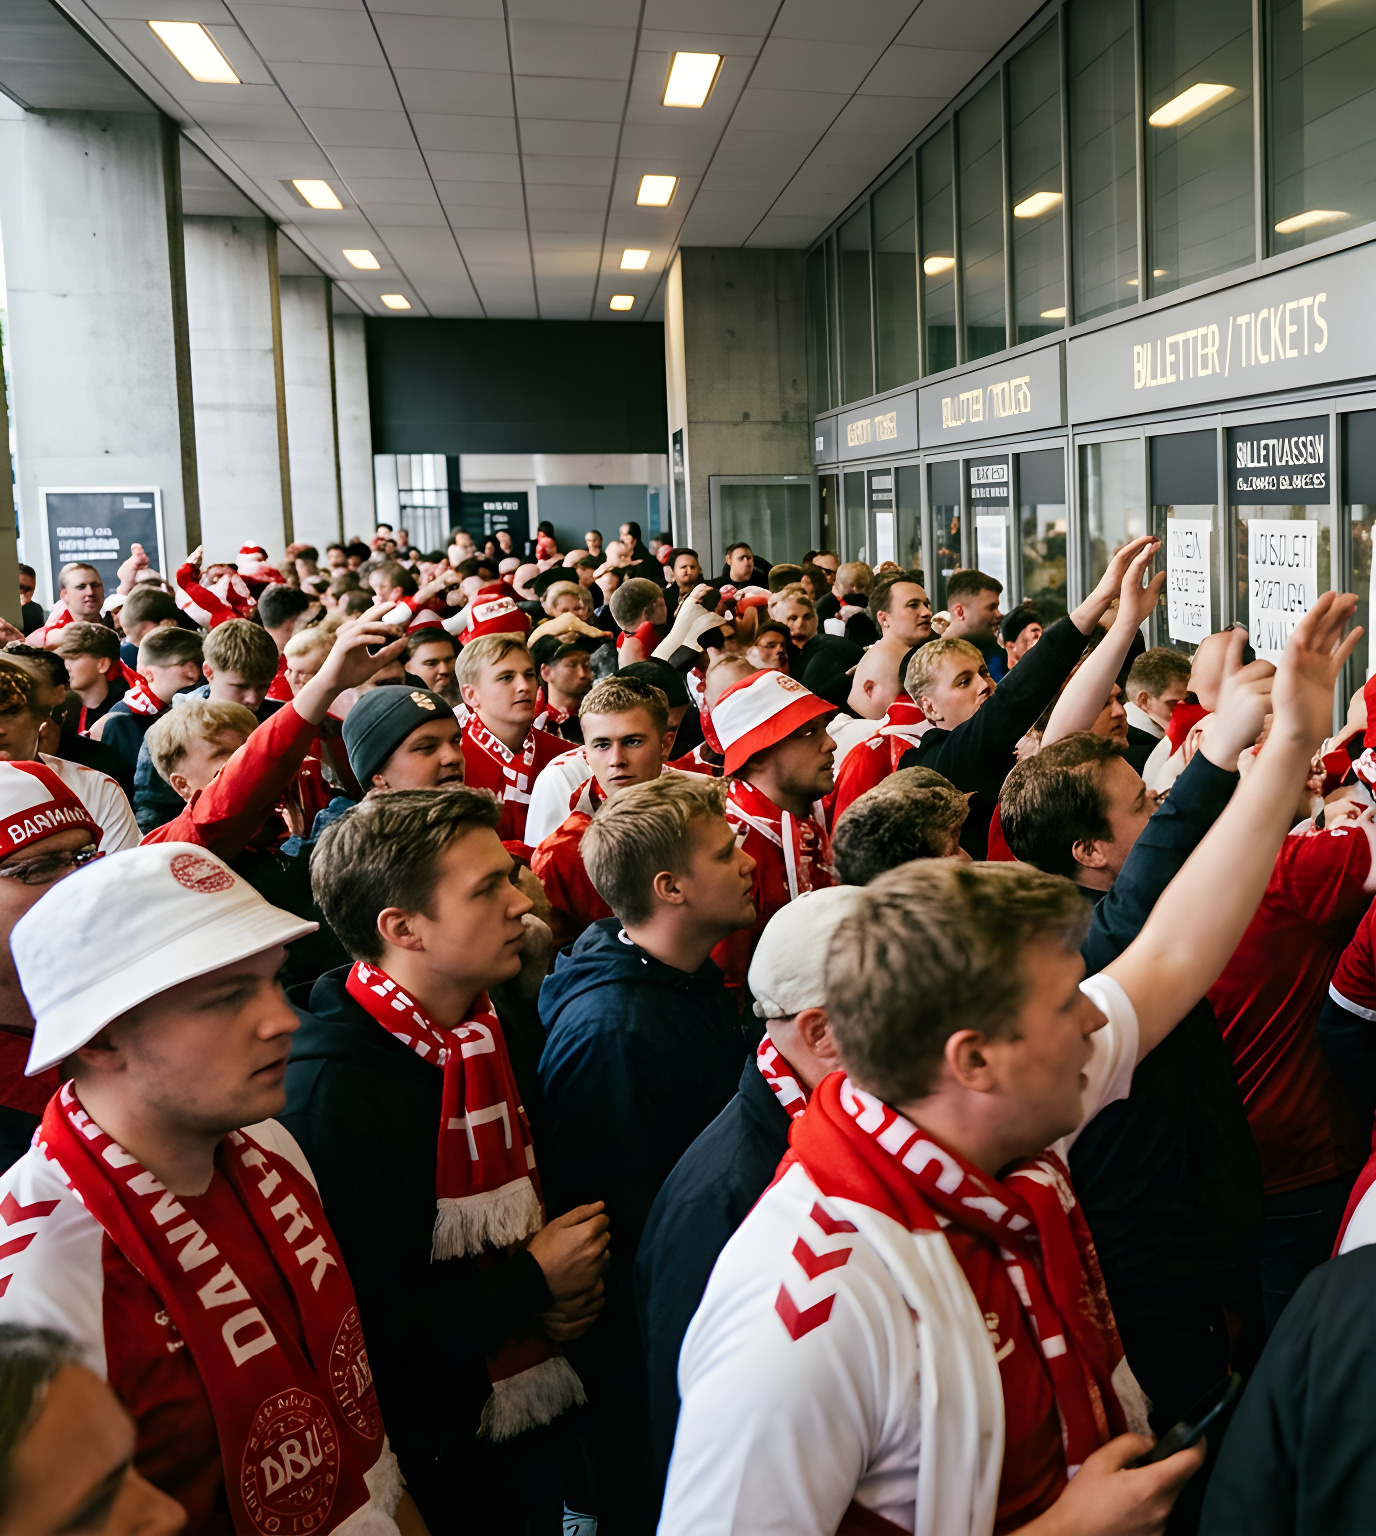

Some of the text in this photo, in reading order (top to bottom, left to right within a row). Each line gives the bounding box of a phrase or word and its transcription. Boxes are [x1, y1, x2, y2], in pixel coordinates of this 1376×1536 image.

[1133, 323, 1221, 390] BILLETTER
[1236, 292, 1329, 368] TICKETS
[260, 1423, 324, 1498] DBU
